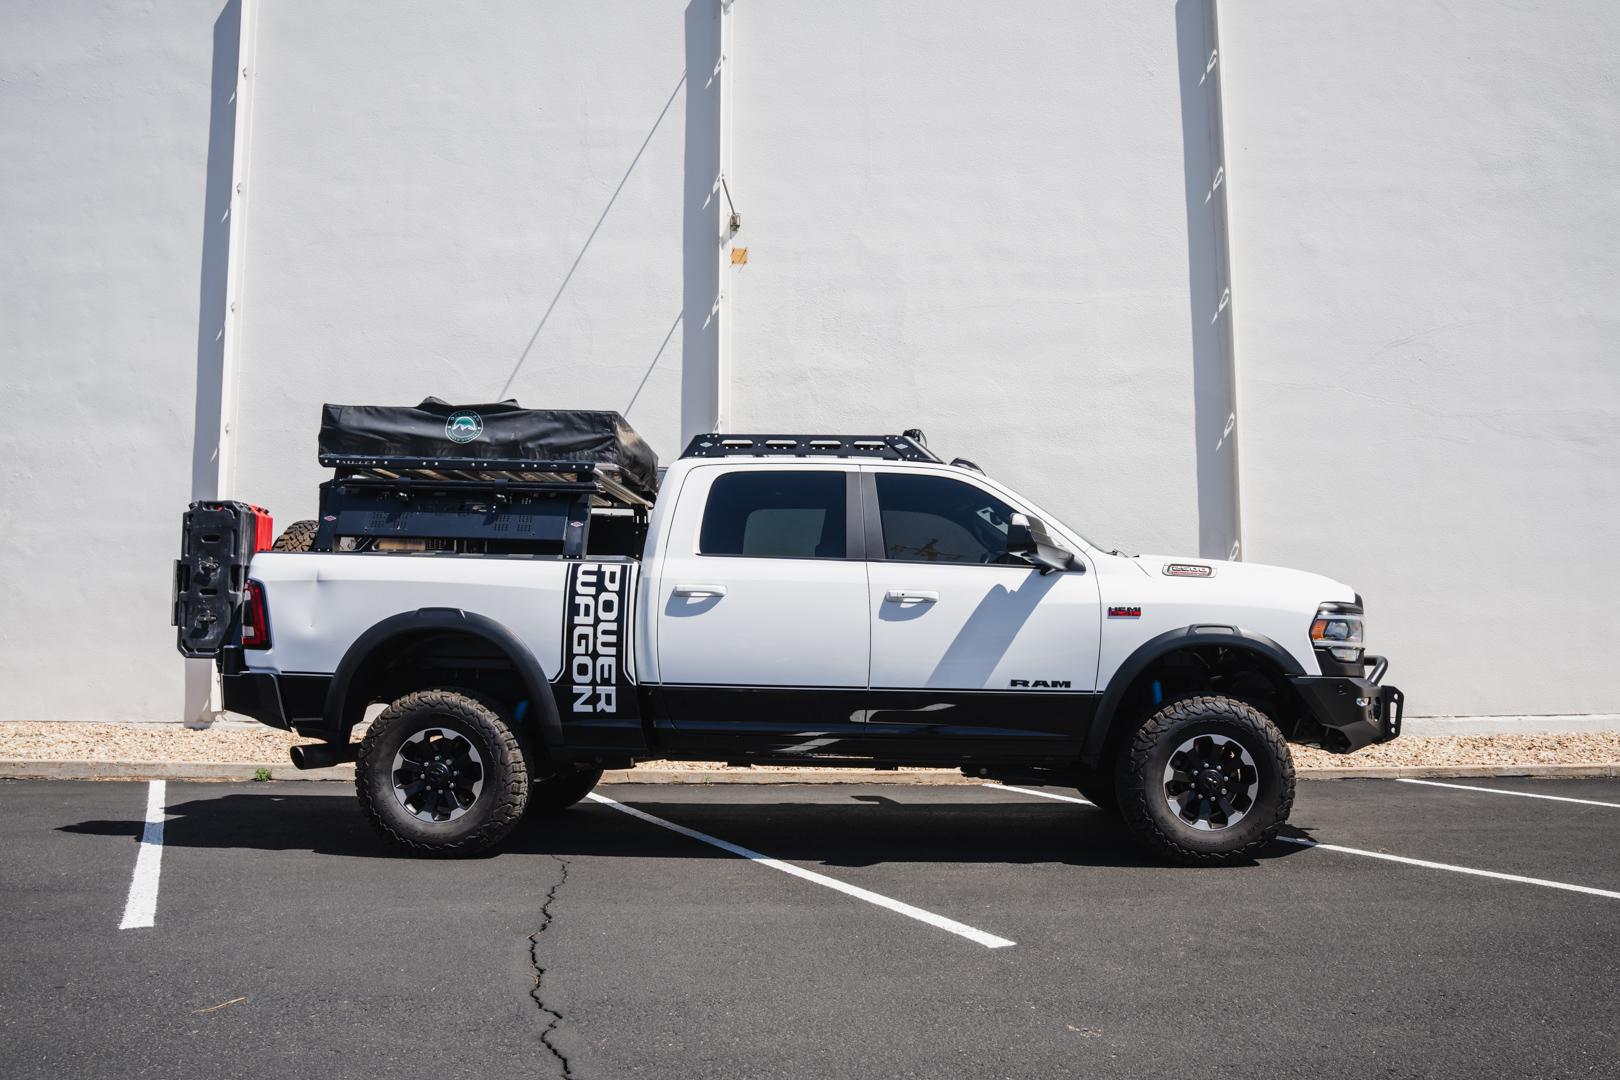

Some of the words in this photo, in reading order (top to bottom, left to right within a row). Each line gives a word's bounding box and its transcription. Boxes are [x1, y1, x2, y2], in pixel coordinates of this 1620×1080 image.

[572, 562, 599, 713] WAGON
[595, 563, 622, 713] POWER
[1010, 679, 1072, 689] RAM
